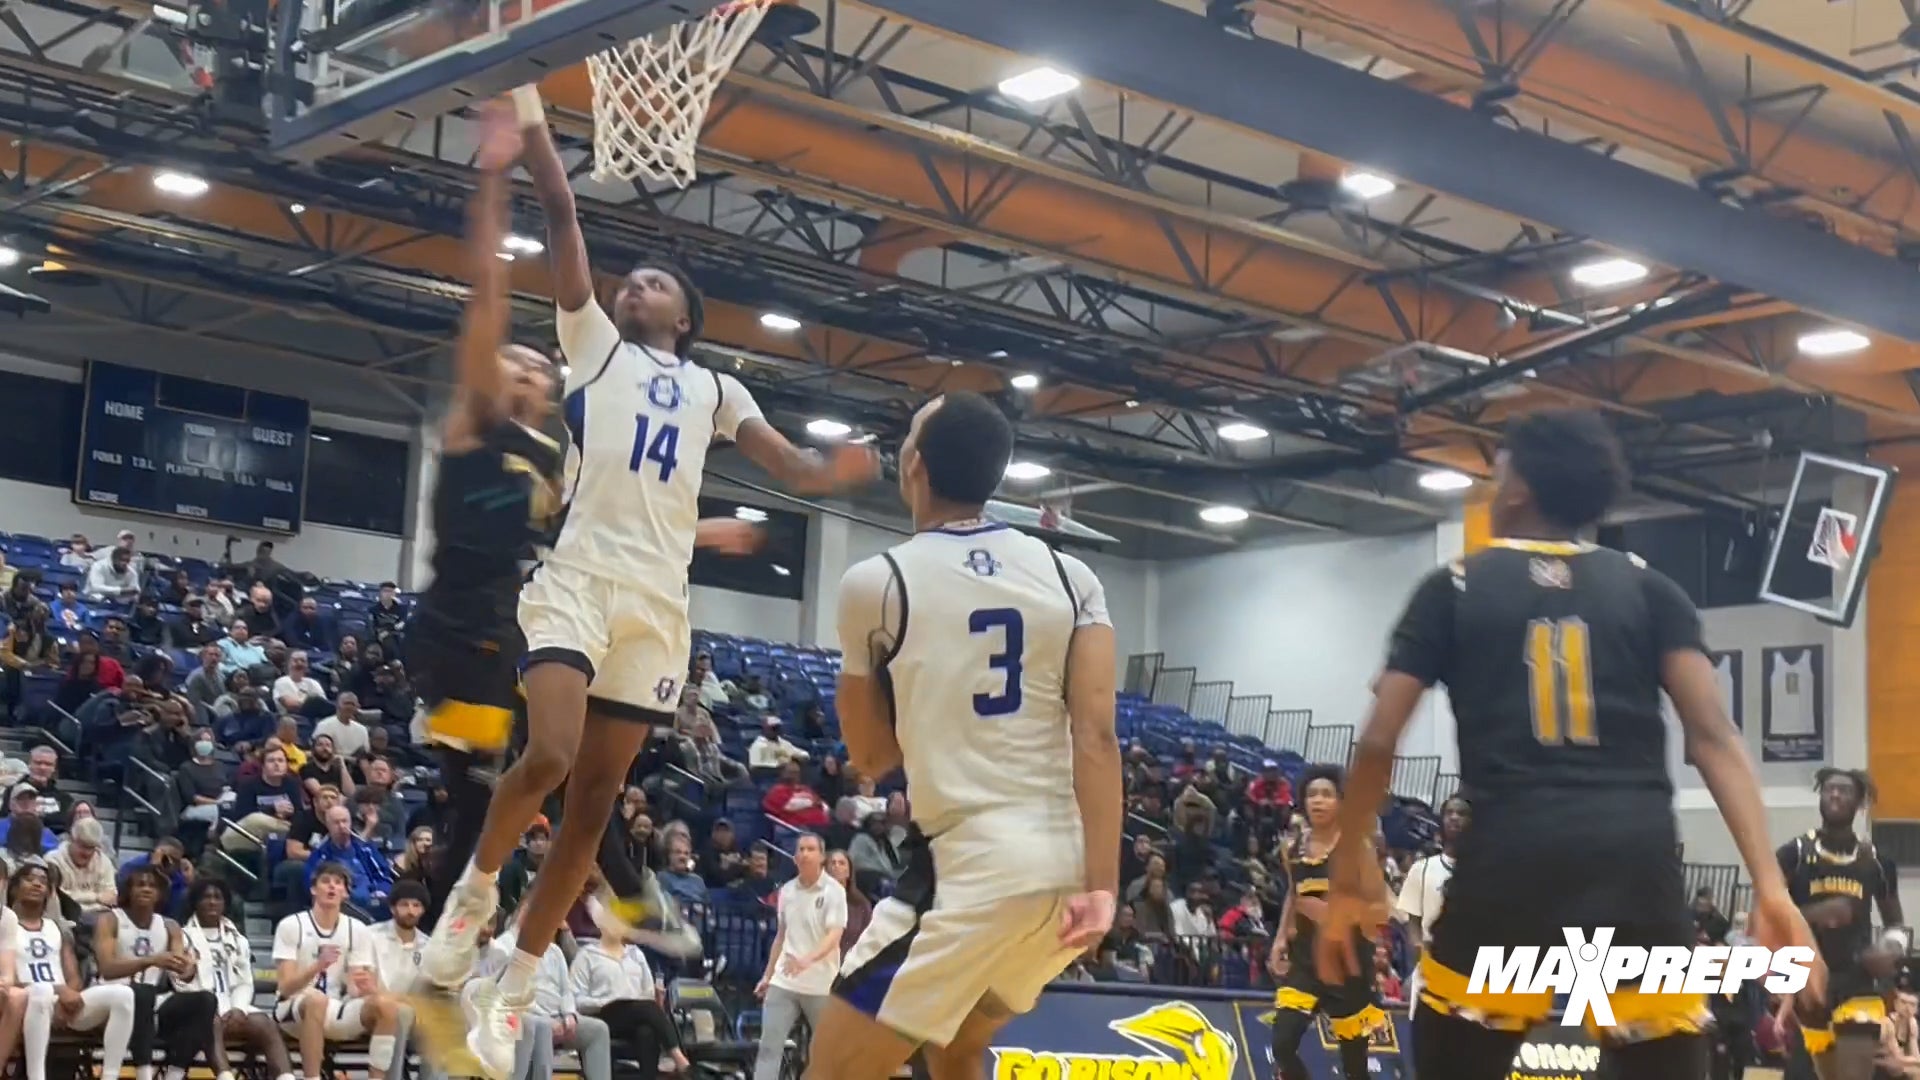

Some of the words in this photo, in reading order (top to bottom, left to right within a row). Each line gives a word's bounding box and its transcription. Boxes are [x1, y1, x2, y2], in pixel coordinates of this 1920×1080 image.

[105, 401, 144, 421] HOME
[253, 427, 294, 446] GUEST
[629, 413, 680, 482] 14
[969, 607, 1024, 716] 3
[1522, 615, 1600, 745] 11
[28, 961, 55, 983] 10
